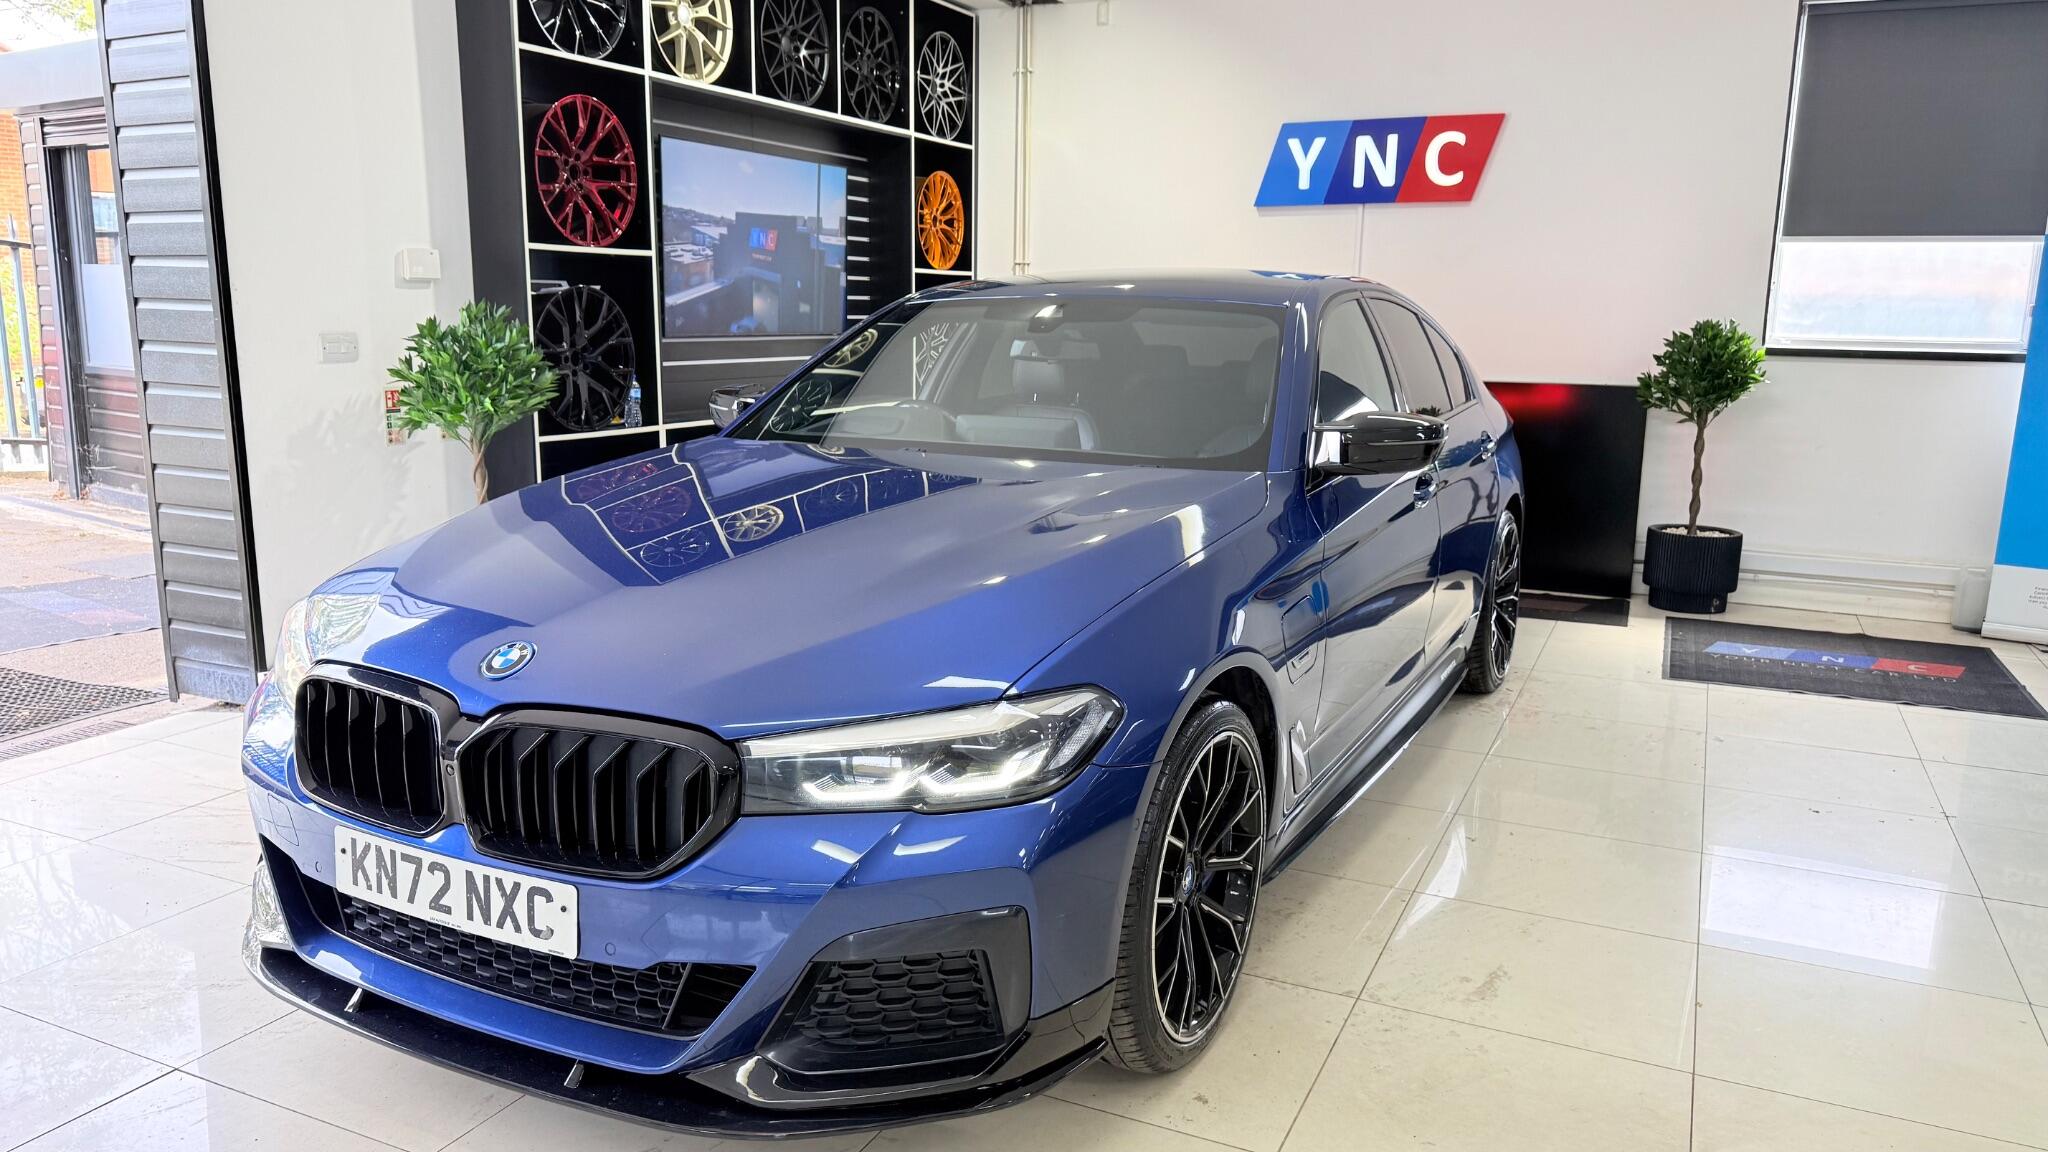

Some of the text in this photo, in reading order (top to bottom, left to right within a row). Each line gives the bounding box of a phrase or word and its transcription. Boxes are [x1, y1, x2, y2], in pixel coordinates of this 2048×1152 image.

[1287, 131, 1466, 190] YNC
[351, 837, 554, 940] KN72 NXC
